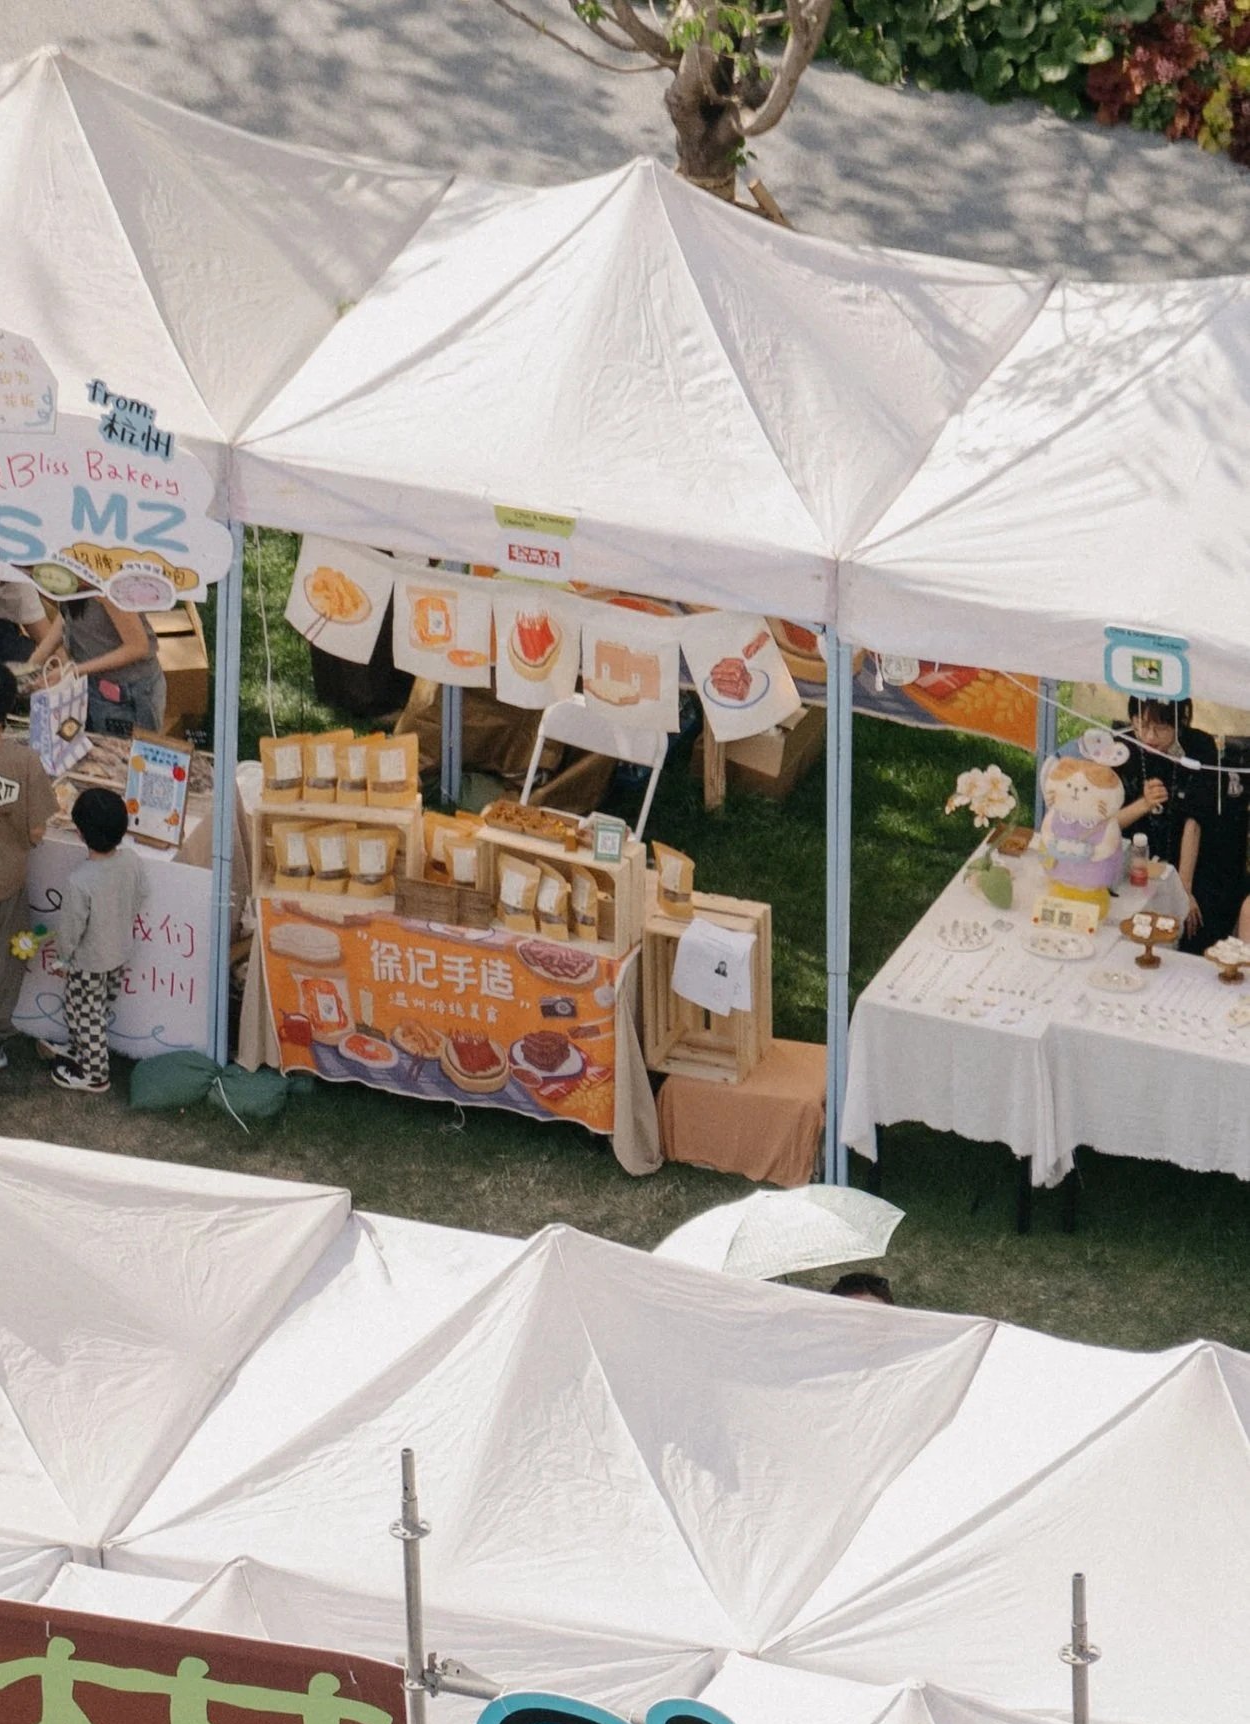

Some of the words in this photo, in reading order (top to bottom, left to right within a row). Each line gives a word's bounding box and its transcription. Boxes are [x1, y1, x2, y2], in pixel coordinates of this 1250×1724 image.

[86, 380, 153, 420] from:
[100, 413, 171, 457] 杭州
[8, 452, 69, 488] Bliss
[86, 450, 180, 496] Bakery
